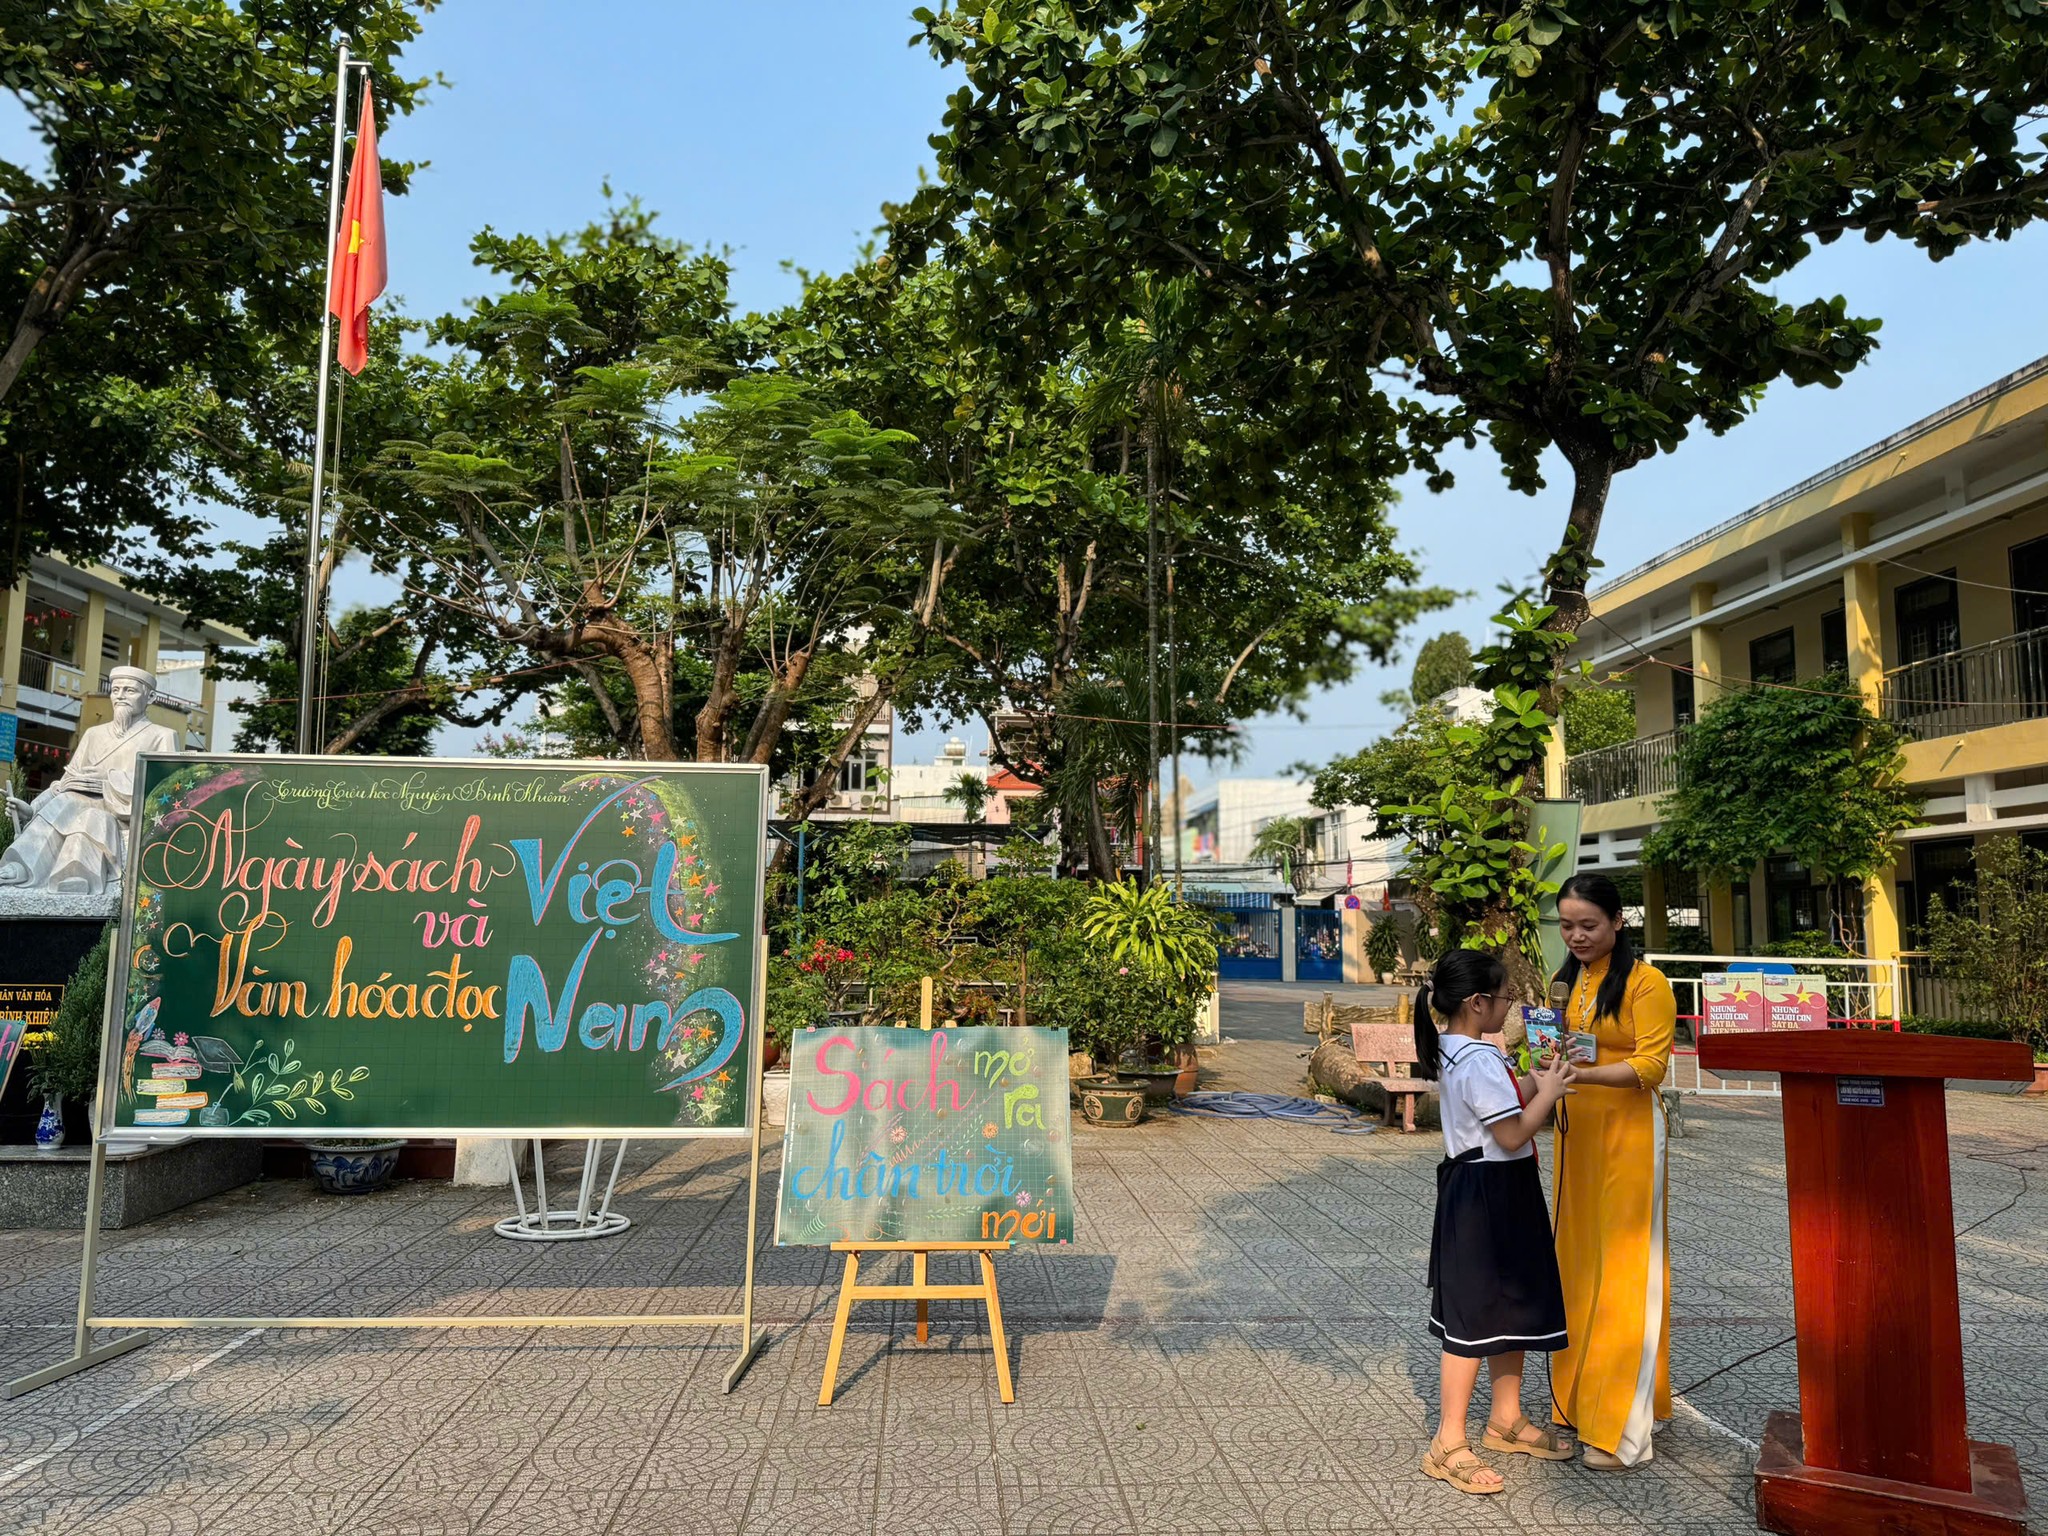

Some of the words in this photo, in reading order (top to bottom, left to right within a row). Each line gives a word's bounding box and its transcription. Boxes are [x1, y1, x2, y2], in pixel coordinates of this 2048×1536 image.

[272, 779, 332, 810] Trường
[326, 780, 366, 802] Tiểu
[384, 771, 452, 814] Nguyễn
[512, 776, 570, 803] Khiêm
[143, 783, 354, 930] Ngày
[352, 815, 514, 893] sách
[509, 776, 740, 945] Việt
[413, 897, 493, 949] và
[16, 989, 33, 1001] VĂN
[35, 989, 52, 1001] HÓA
[322, 935, 419, 1018] hóa
[422, 953, 502, 1032] đọc
[503, 927, 745, 1093] Nam
[807, 1031, 976, 1116] Sách
[974, 1037, 1035, 1090] mở
[1004, 1084, 1046, 1129] ra
[792, 1119, 922, 1201] chân
[928, 1144, 1022, 1197] trời
[981, 1199, 1056, 1240] mới
